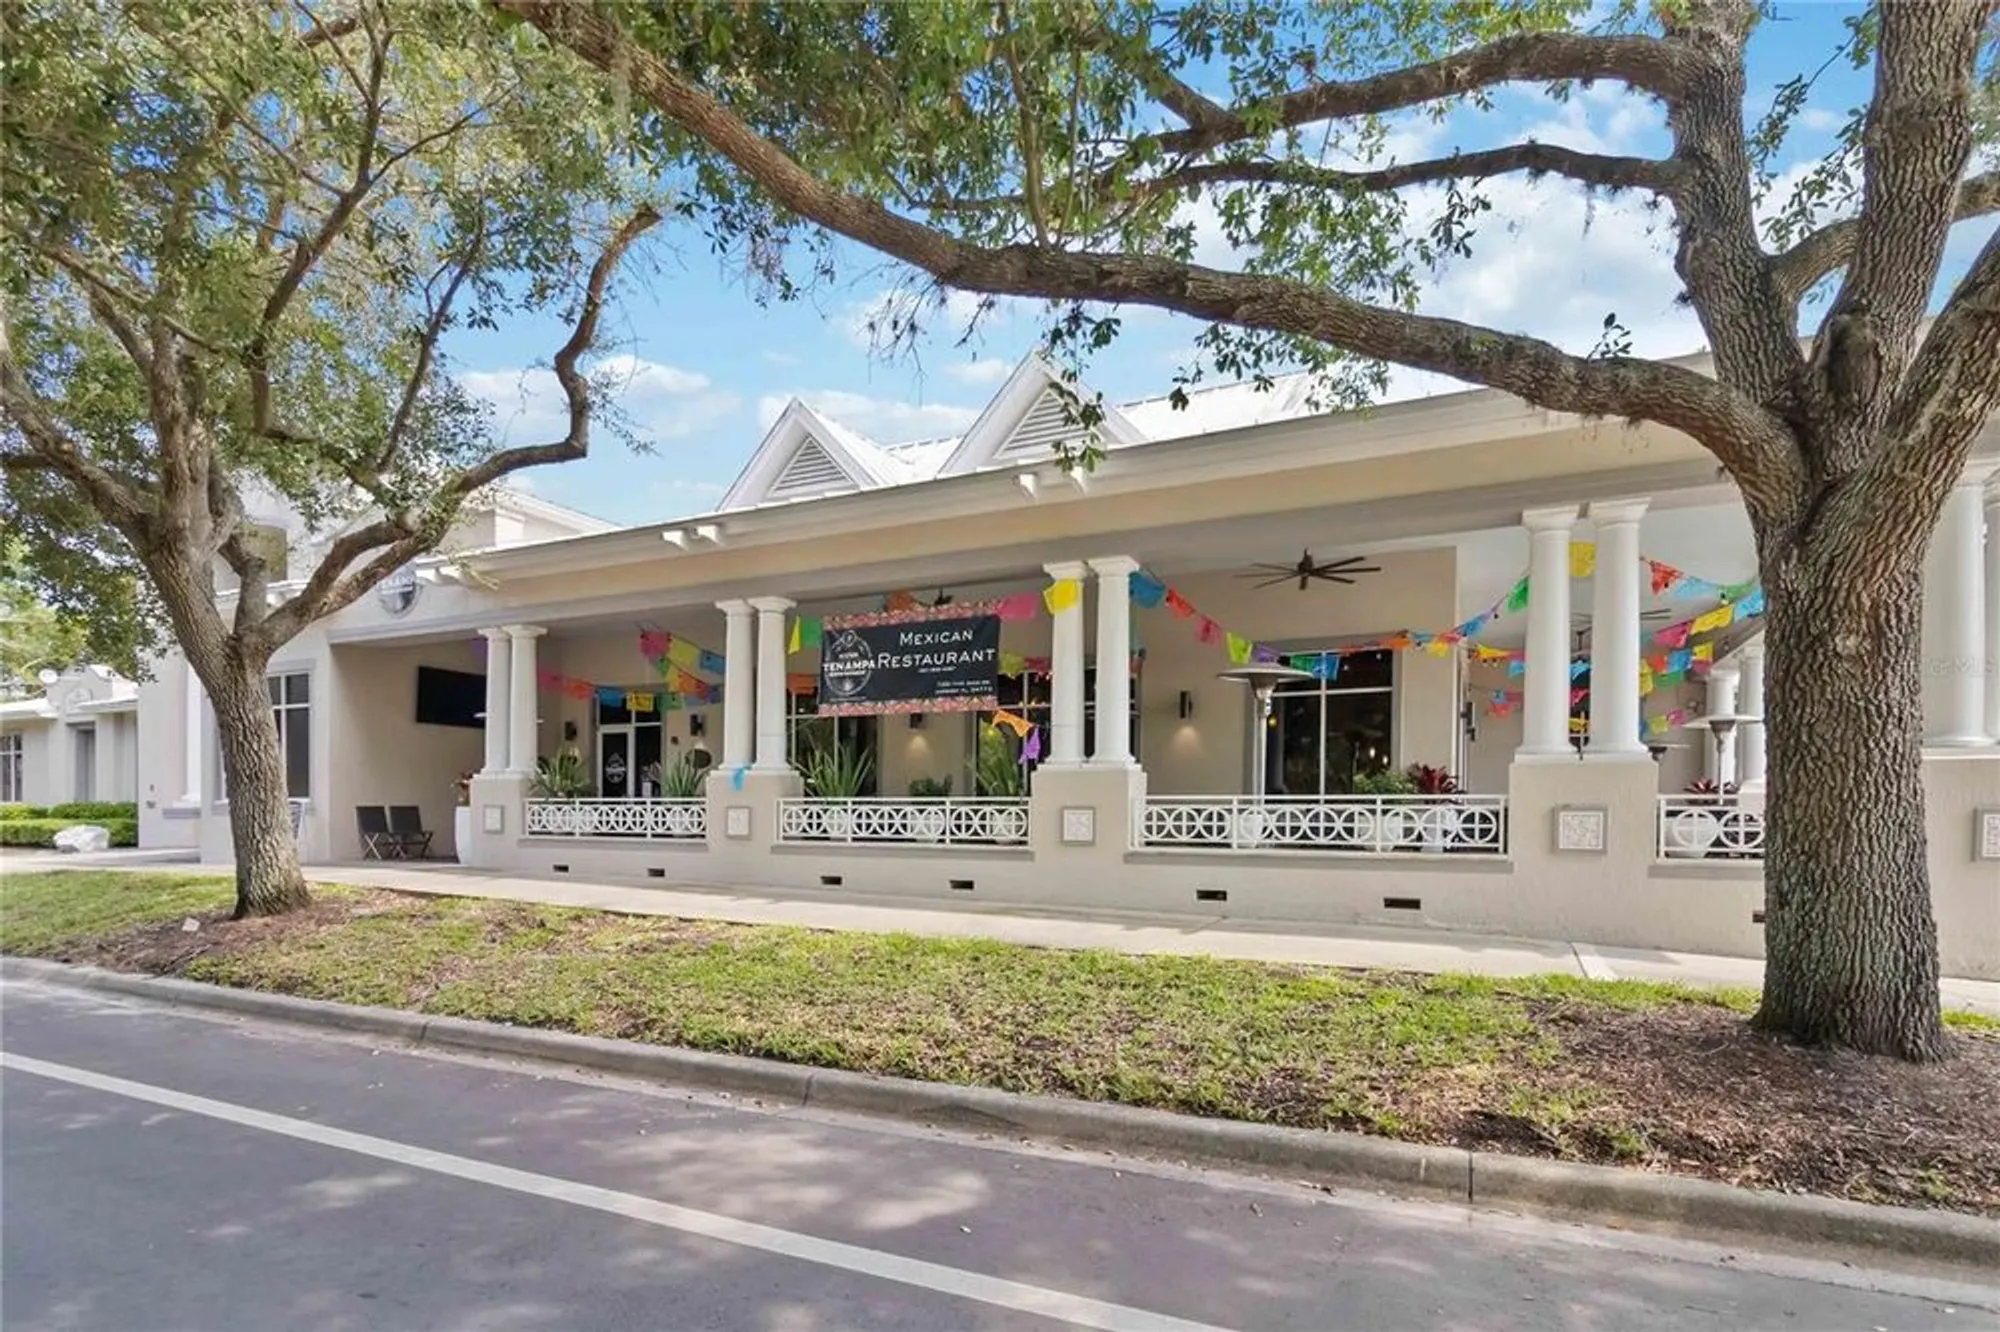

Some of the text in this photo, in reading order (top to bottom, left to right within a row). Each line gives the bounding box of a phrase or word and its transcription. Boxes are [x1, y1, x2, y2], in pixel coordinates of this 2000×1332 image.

[900, 629, 973, 646] MEXICAN
[823, 660, 875, 671] TENAMPA
[878, 648, 995, 667] RESTAURANT
